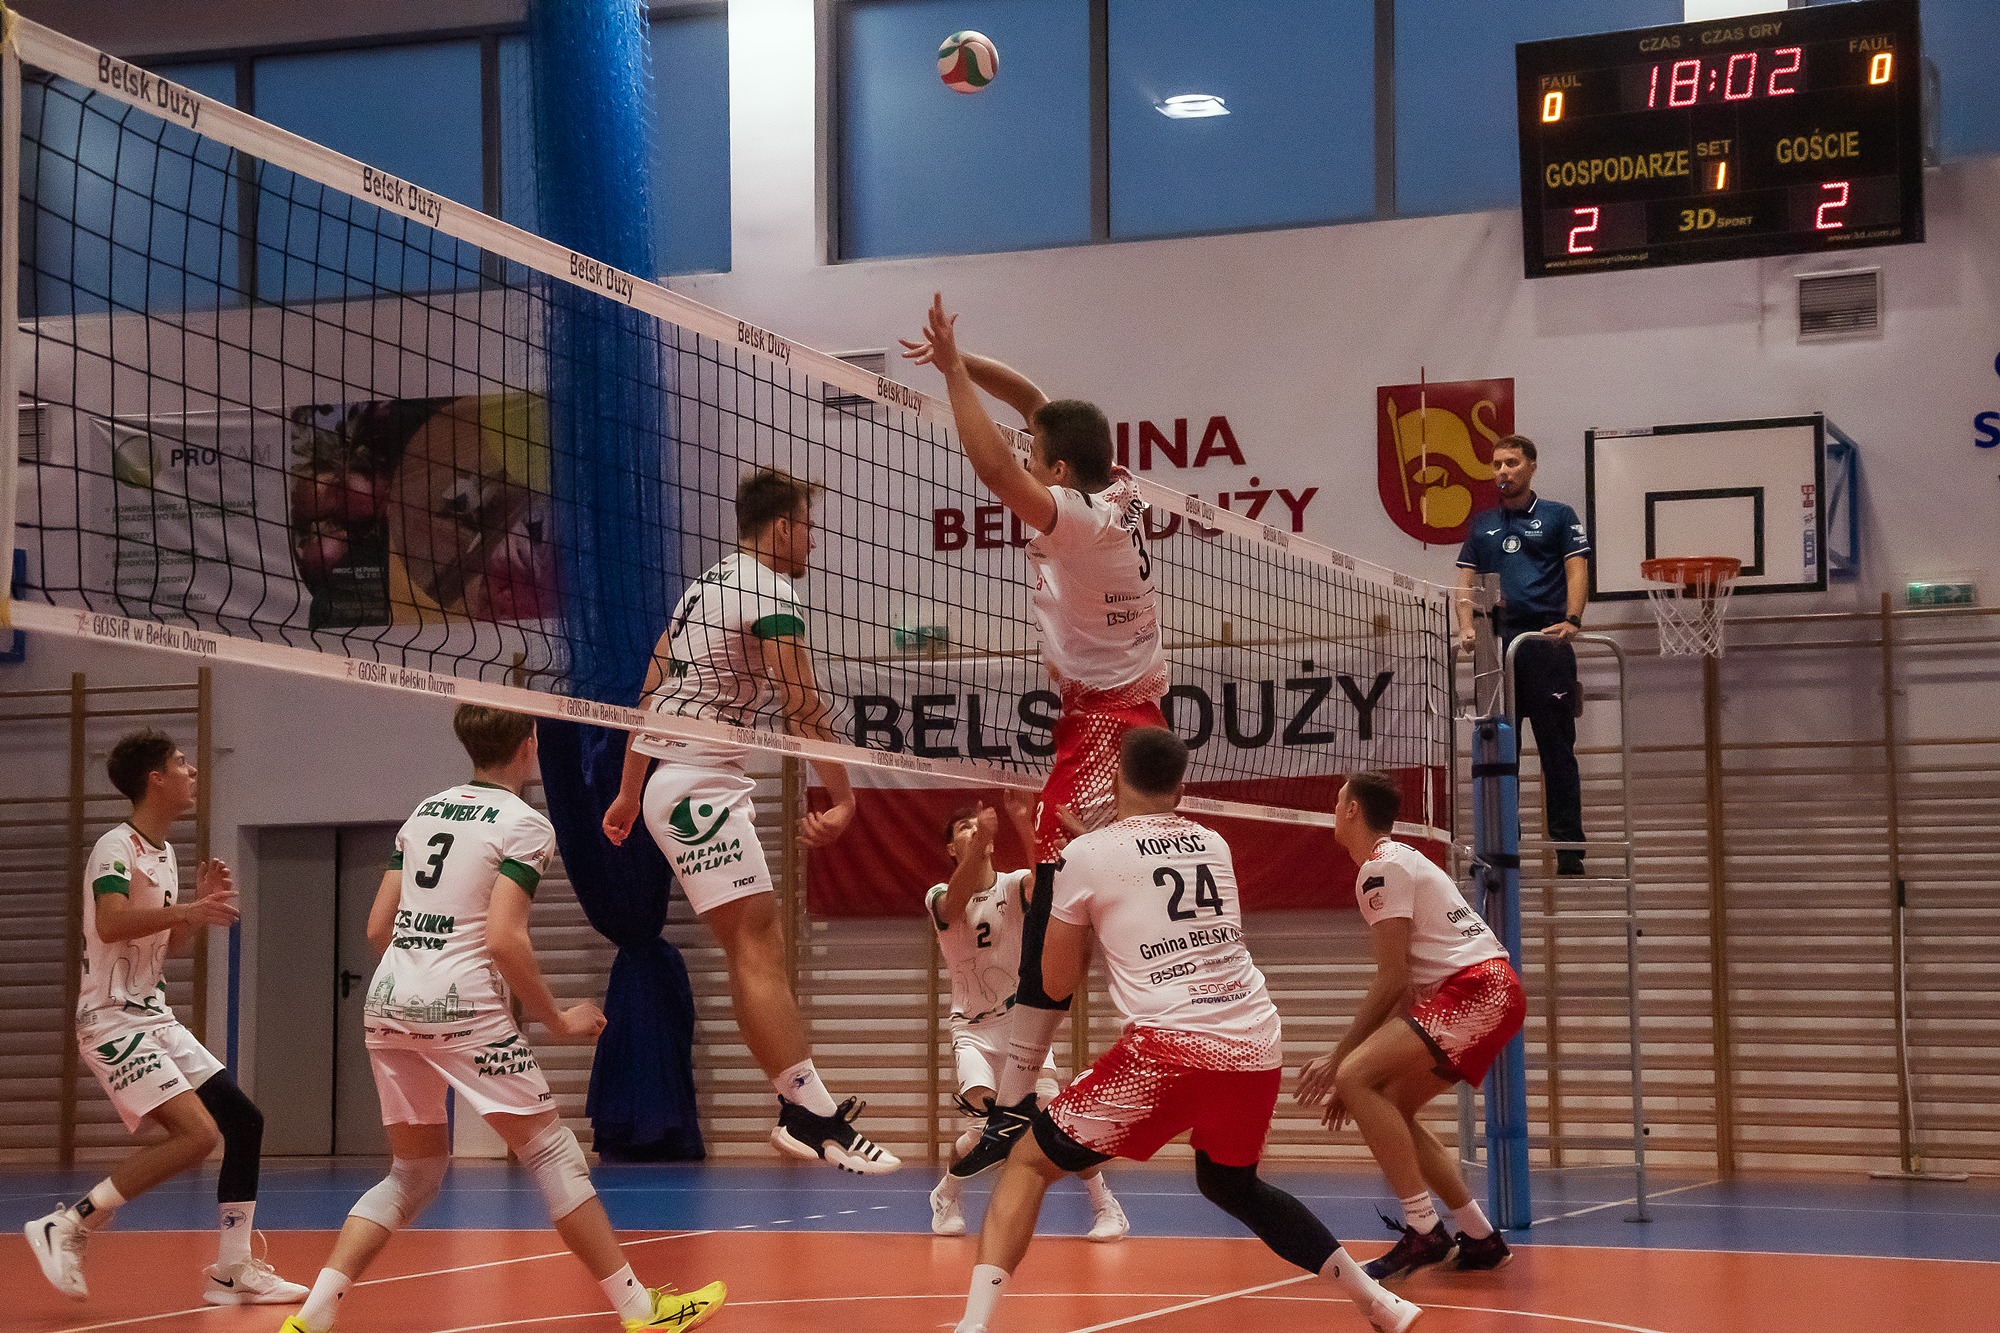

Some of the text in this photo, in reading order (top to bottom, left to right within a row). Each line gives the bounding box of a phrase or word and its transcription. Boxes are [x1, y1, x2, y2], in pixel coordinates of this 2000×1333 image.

[1639, 35, 1681, 52] CZAS
[1701, 27, 1744, 45] CZAS
[1749, 22, 1782, 38] GRY
[1850, 35, 1894, 53] FAUL
[1541, 75, 1582, 89] FAUL
[1648, 47, 1801, 107] 18:02
[1869, 52, 1892, 85] 0
[98, 53, 200, 129] Belsk Duży
[1542, 91, 1563, 123] 0
[1697, 139, 1732, 156] SET
[1776, 127, 1860, 164] GOŚCIE
[1546, 150, 1690, 188] GOSPODARZE
[1716, 161, 1727, 190] 1
[363, 166, 442, 228] Belsk Duży
[1816, 181, 1849, 230] 2
[1568, 206, 1599, 254] 2
[1679, 207, 1716, 232] 3D
[570, 253, 634, 305] Belsk Duży
[737, 321, 791, 365] Belsk Duży
[877, 376, 901, 403] Belsk
[1116, 415, 1246, 471] INA
[934, 504, 1034, 552] BEL
[1132, 527, 1150, 581] 3
[93, 615, 217, 658] GOSiR w Belsku Dużym
[358, 662, 387, 684] GOSiR
[389, 672, 398, 685] w
[400, 669, 426, 691] Belsku
[853, 690, 1063, 759] BELS
[481, 807, 500, 824] M.
[415, 832, 455, 889] 3
[676, 838, 740, 865] WARMIA
[681, 851, 744, 878] MAZURY
[733, 876, 755, 888] TICO
[1153, 863, 1224, 921] 24
[414, 912, 455, 933] UWM
[975, 921, 992, 948] 2
[1140, 937, 1188, 960] Gmina
[1188, 927, 1231, 948] BELSK
